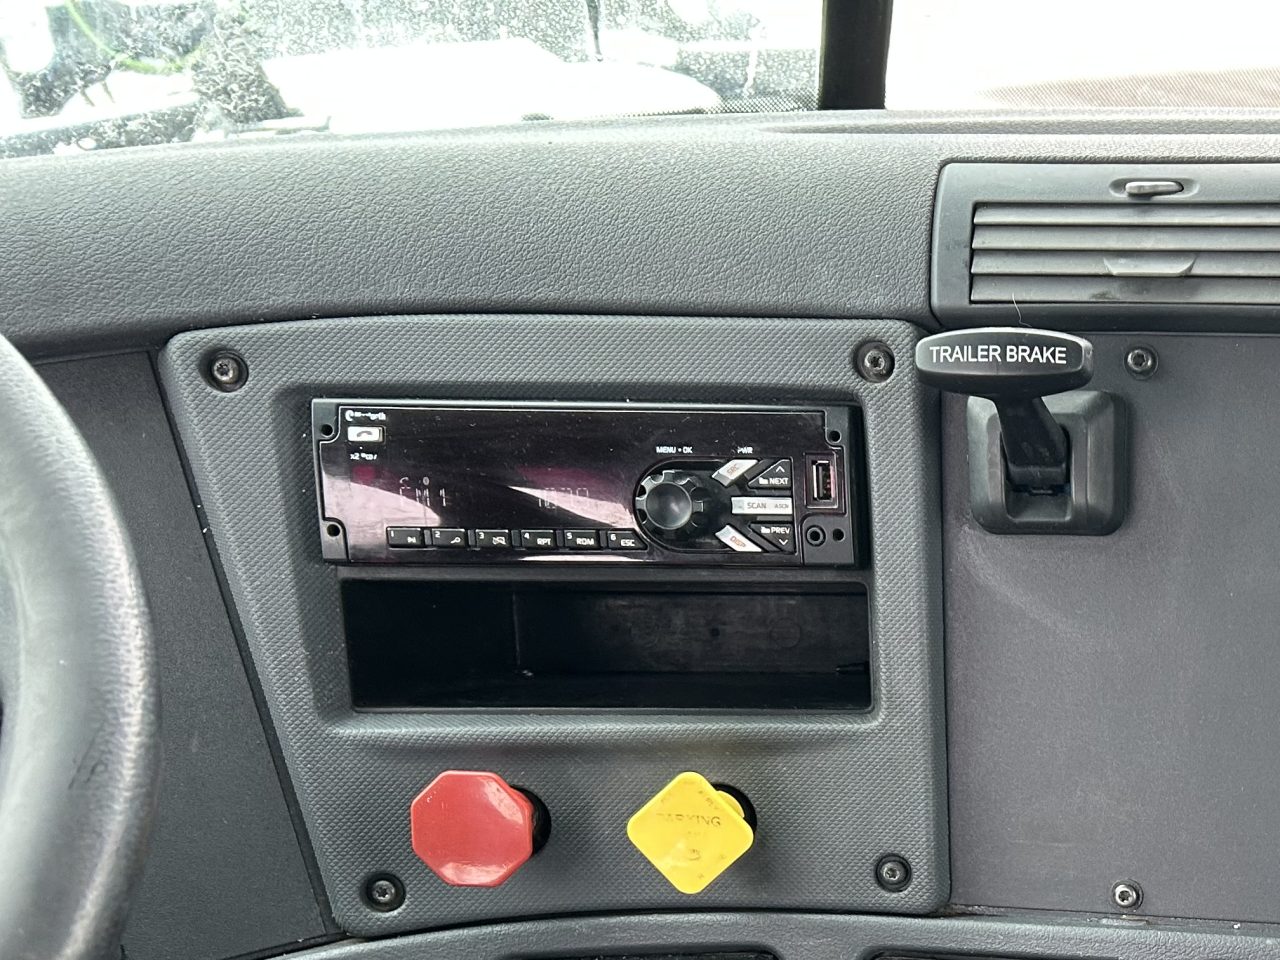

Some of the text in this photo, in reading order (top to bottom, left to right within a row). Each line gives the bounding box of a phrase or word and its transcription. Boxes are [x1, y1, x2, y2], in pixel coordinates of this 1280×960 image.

[929, 345, 1067, 365] TRAILER BRAKE
[655, 446, 693, 454] MENU OK
[769, 477, 789, 485] NEXT
[746, 502, 767, 510] SCAN
[434, 530, 441, 538] 2
[770, 526, 791, 535] PREV
[523, 532, 530, 540] 4
[566, 532, 573, 540] 5
[536, 538, 552, 546] RPT
[620, 538, 636, 547] ESC
